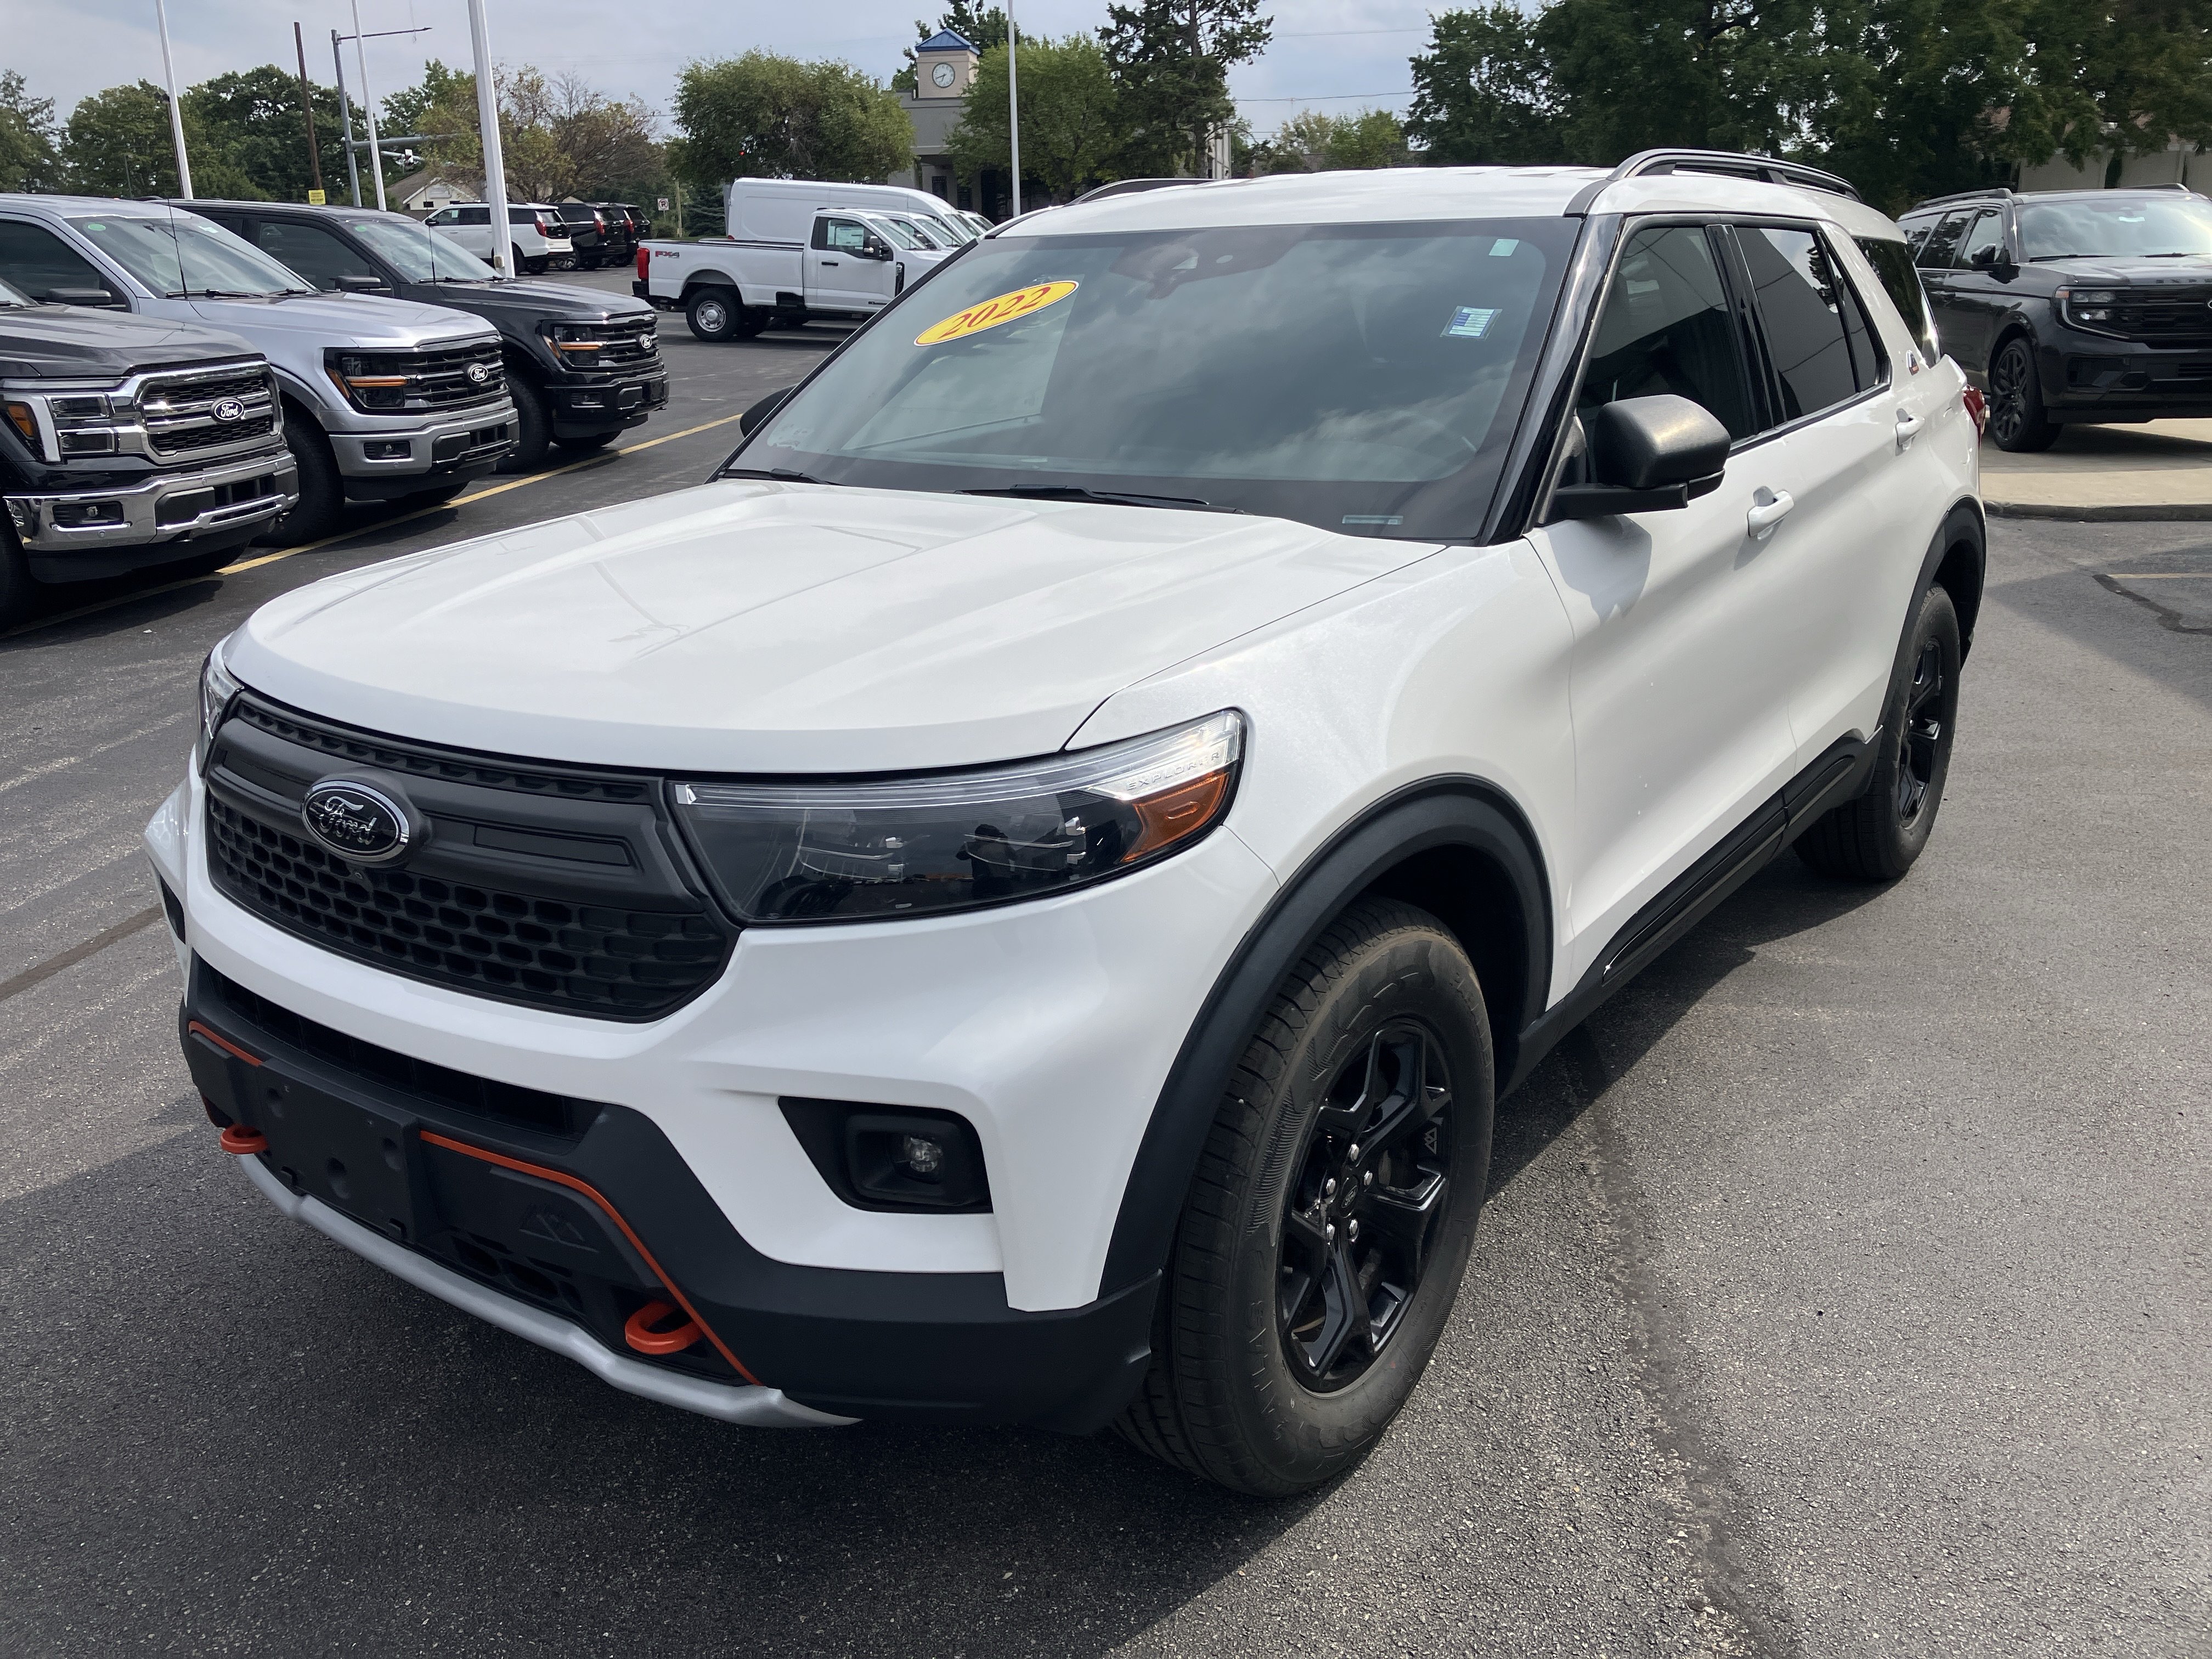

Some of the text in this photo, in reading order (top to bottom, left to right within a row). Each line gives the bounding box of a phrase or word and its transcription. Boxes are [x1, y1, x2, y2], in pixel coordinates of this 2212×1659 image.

[937, 287, 1051, 339] 2022
[221, 403, 238, 417] Ford
[1126, 752, 1219, 790] EXPLORER
[319, 796, 377, 845] Ford
